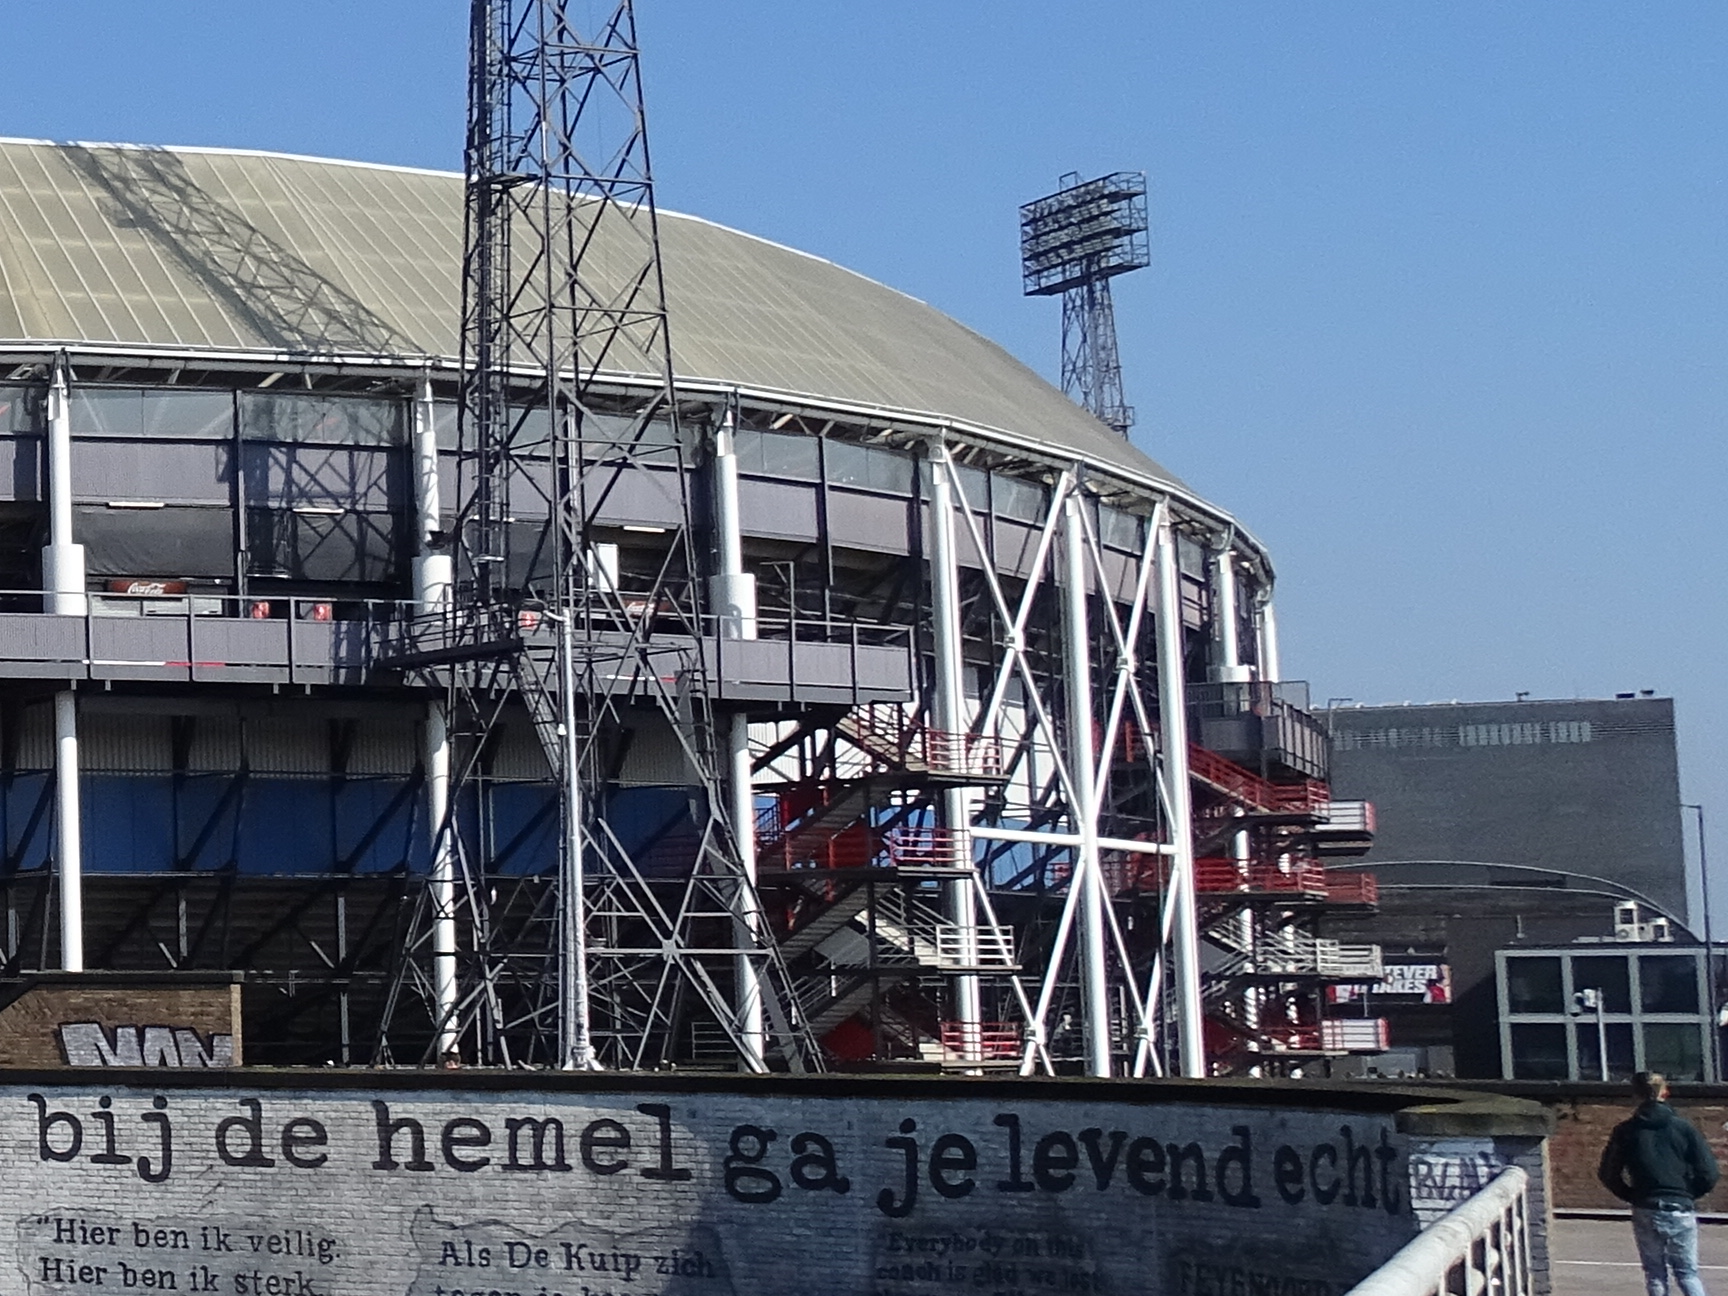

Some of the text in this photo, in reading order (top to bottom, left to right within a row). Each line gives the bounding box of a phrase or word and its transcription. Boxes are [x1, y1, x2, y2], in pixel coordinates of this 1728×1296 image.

[28, 1093, 172, 1183] bij
[215, 1096, 328, 1169] de
[370, 1099, 692, 1182] hemel
[723, 1124, 851, 1204] ga
[877, 1117, 978, 1218] je
[994, 1113, 1262, 1208] levend
[1273, 1124, 1401, 1215] echt
[132, 1222, 189, 1249] ben
[200, 1226, 232, 1252] ik
[246, 1231, 341, 1263] veilig.
[439, 1240, 716, 1282] Als De Kuip zich
[39, 1256, 108, 1285] Hier
[118, 1262, 178, 1290] ben
[189, 1266, 220, 1292] ik
